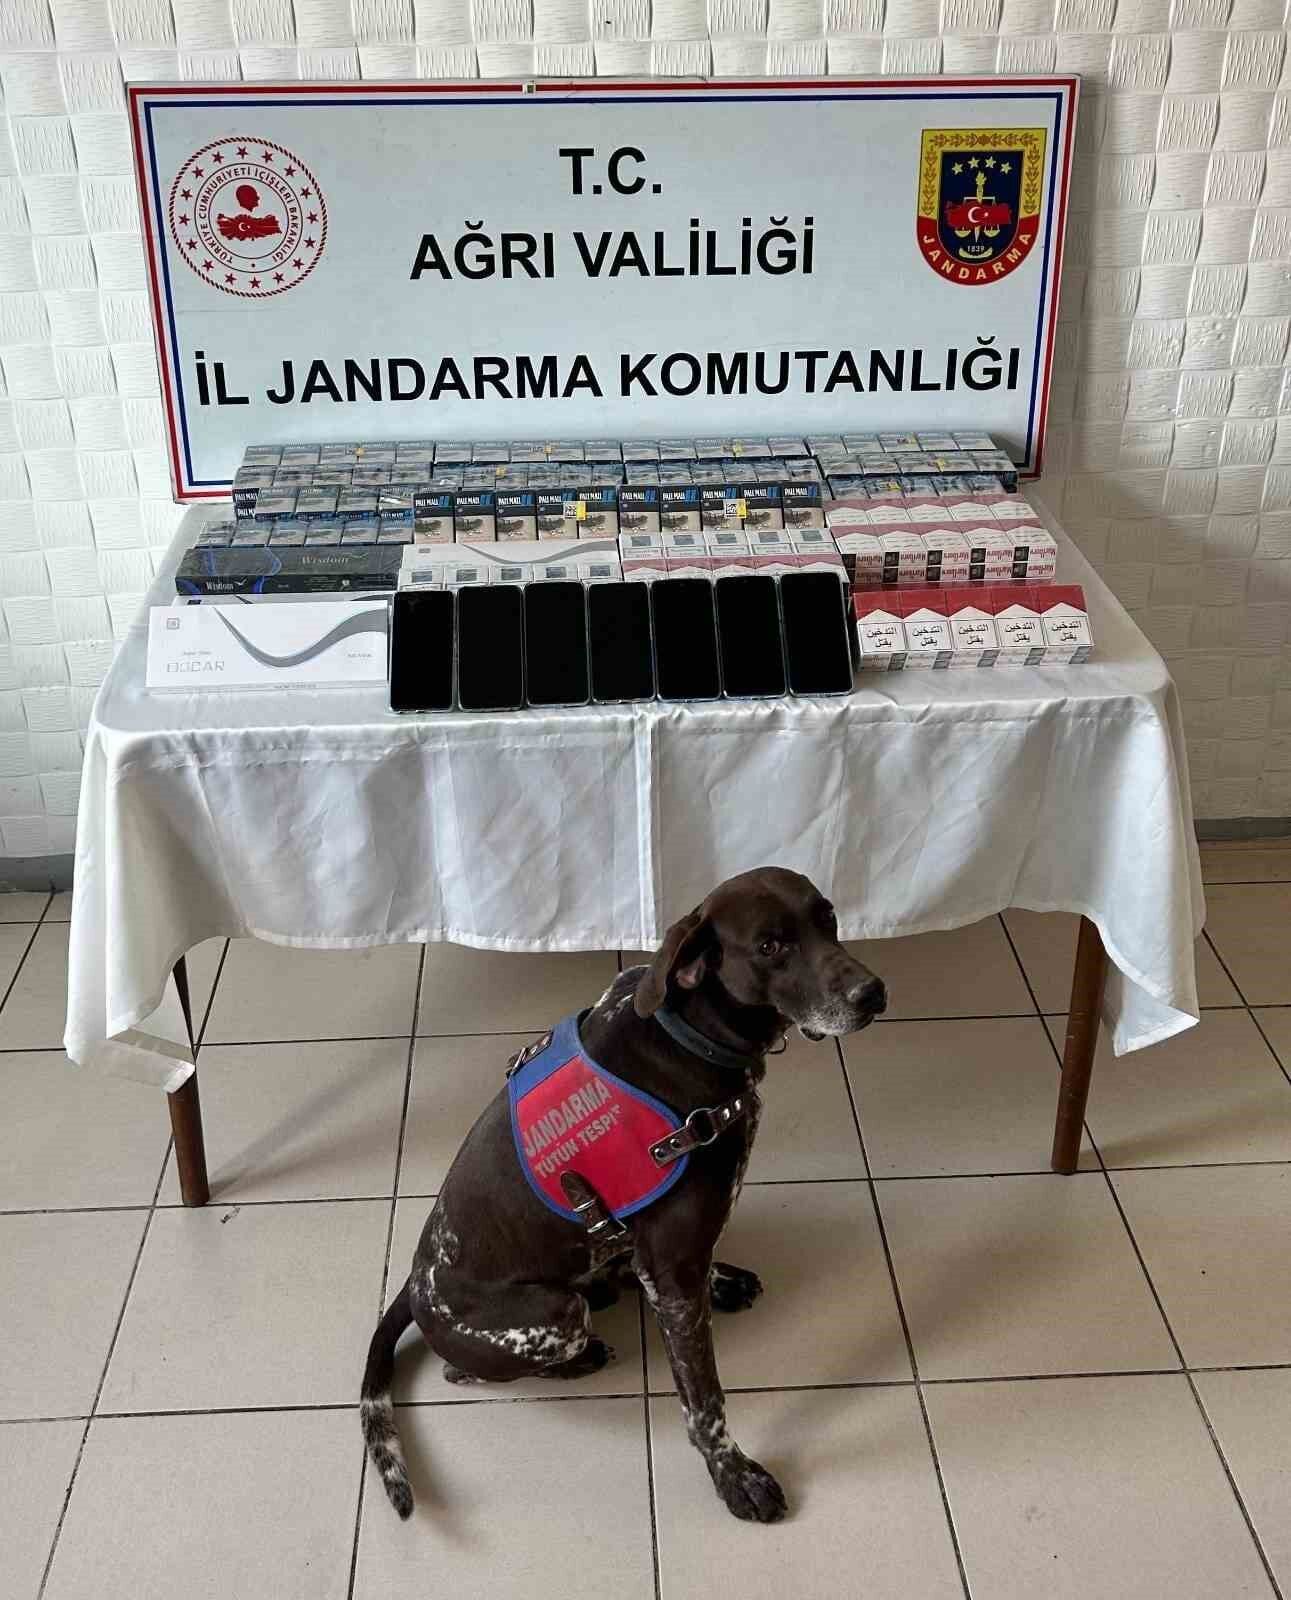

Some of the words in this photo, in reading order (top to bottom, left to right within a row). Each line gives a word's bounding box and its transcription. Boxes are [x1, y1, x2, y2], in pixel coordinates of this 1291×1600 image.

[558, 146, 663, 196] T.C.
[272, 207, 299, 263] BAKANLIĞI
[409, 219, 555, 281] AĞRI
[572, 216, 815, 279] VALİLİĞİ
[923, 232, 1032, 280] JANDARMA
[195, 350, 250, 406] İL
[266, 355, 604, 405] JANDARMA
[620, 335, 1021, 398] KOMUTANLIĞI
[867, 626, 897, 638] التدخين
[912, 625, 943, 637] التدخين
[958, 623, 989, 635] التدخين
[1005, 621, 1036, 633] التدخين
[1052, 620, 1082, 632] التدخين
[920, 636, 938, 647] يقتل
[967, 635, 984, 645] يقتل
[1014, 633, 1031, 643] يقتل
[1060, 631, 1077, 642] يقتل
[875, 638, 892, 648] يقتل
[524, 1076, 613, 1158] JANDARMA
